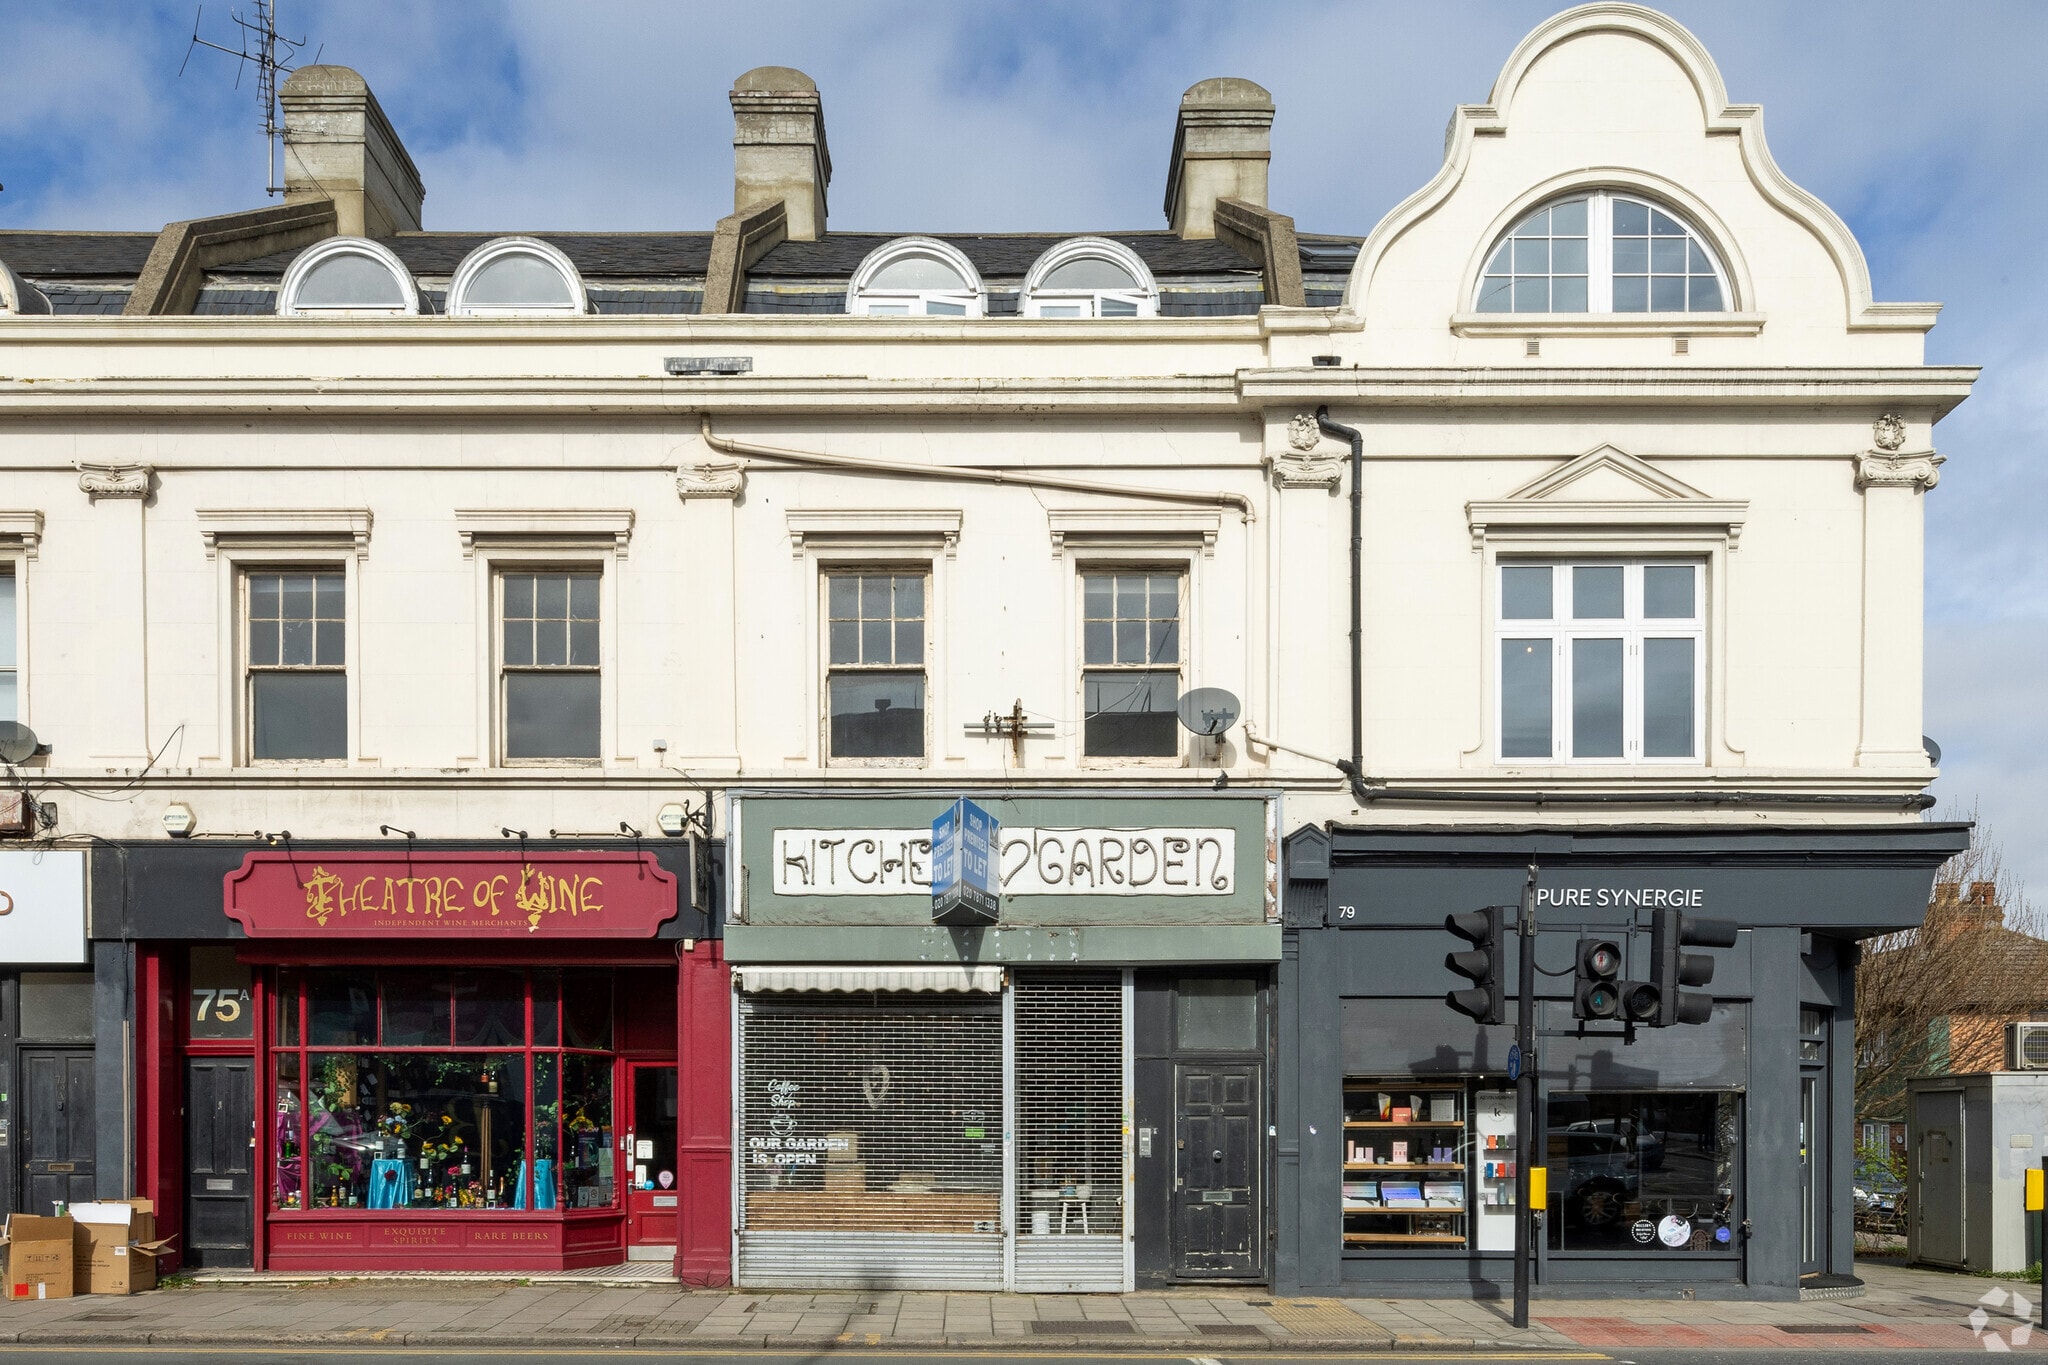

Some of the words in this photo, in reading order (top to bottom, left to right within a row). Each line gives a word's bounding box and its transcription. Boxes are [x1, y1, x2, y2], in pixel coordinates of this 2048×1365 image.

[939, 821, 950, 839] SHOP
[970, 813, 982, 832] SHOP
[934, 835, 954, 859] PREMISES
[964, 828, 987, 853] PREMISES
[783, 839, 932, 887] KITCHE
[934, 862, 943, 883] TO
[943, 854, 954, 879] LET
[963, 847, 973, 870] TO
[973, 857, 987, 878] LET
[304, 866, 465, 926] THEATRE
[473, 875, 508, 916] OF
[515, 863, 604, 927] WINE
[963, 885, 973, 899] 020
[985, 896, 997, 911] 1338
[1536, 888, 1592, 907] PURE
[1596, 888, 1704, 908] SYNERGIE
[1338, 905, 1356, 919] 79
[374, 919, 440, 927] INDEPENDENT
[443, 919, 468, 927] WINE
[471, 919, 528, 927] MERCHANTS
[768, 1079, 800, 1095] Coffee
[770, 1094, 797, 1109] Shop
[749, 1137, 781, 1149] OUR
[785, 1137, 849, 1150] GARDEN
[774, 1154, 817, 1164] OPEN
[287, 1232, 316, 1240] FINE
[319, 1232, 353, 1240] WINE
[383, 1227, 447, 1236] EXQUISITE
[474, 1231, 507, 1240] RARE
[512, 1231, 549, 1240] BEERS
[393, 1236, 438, 1245] SPIRITS
